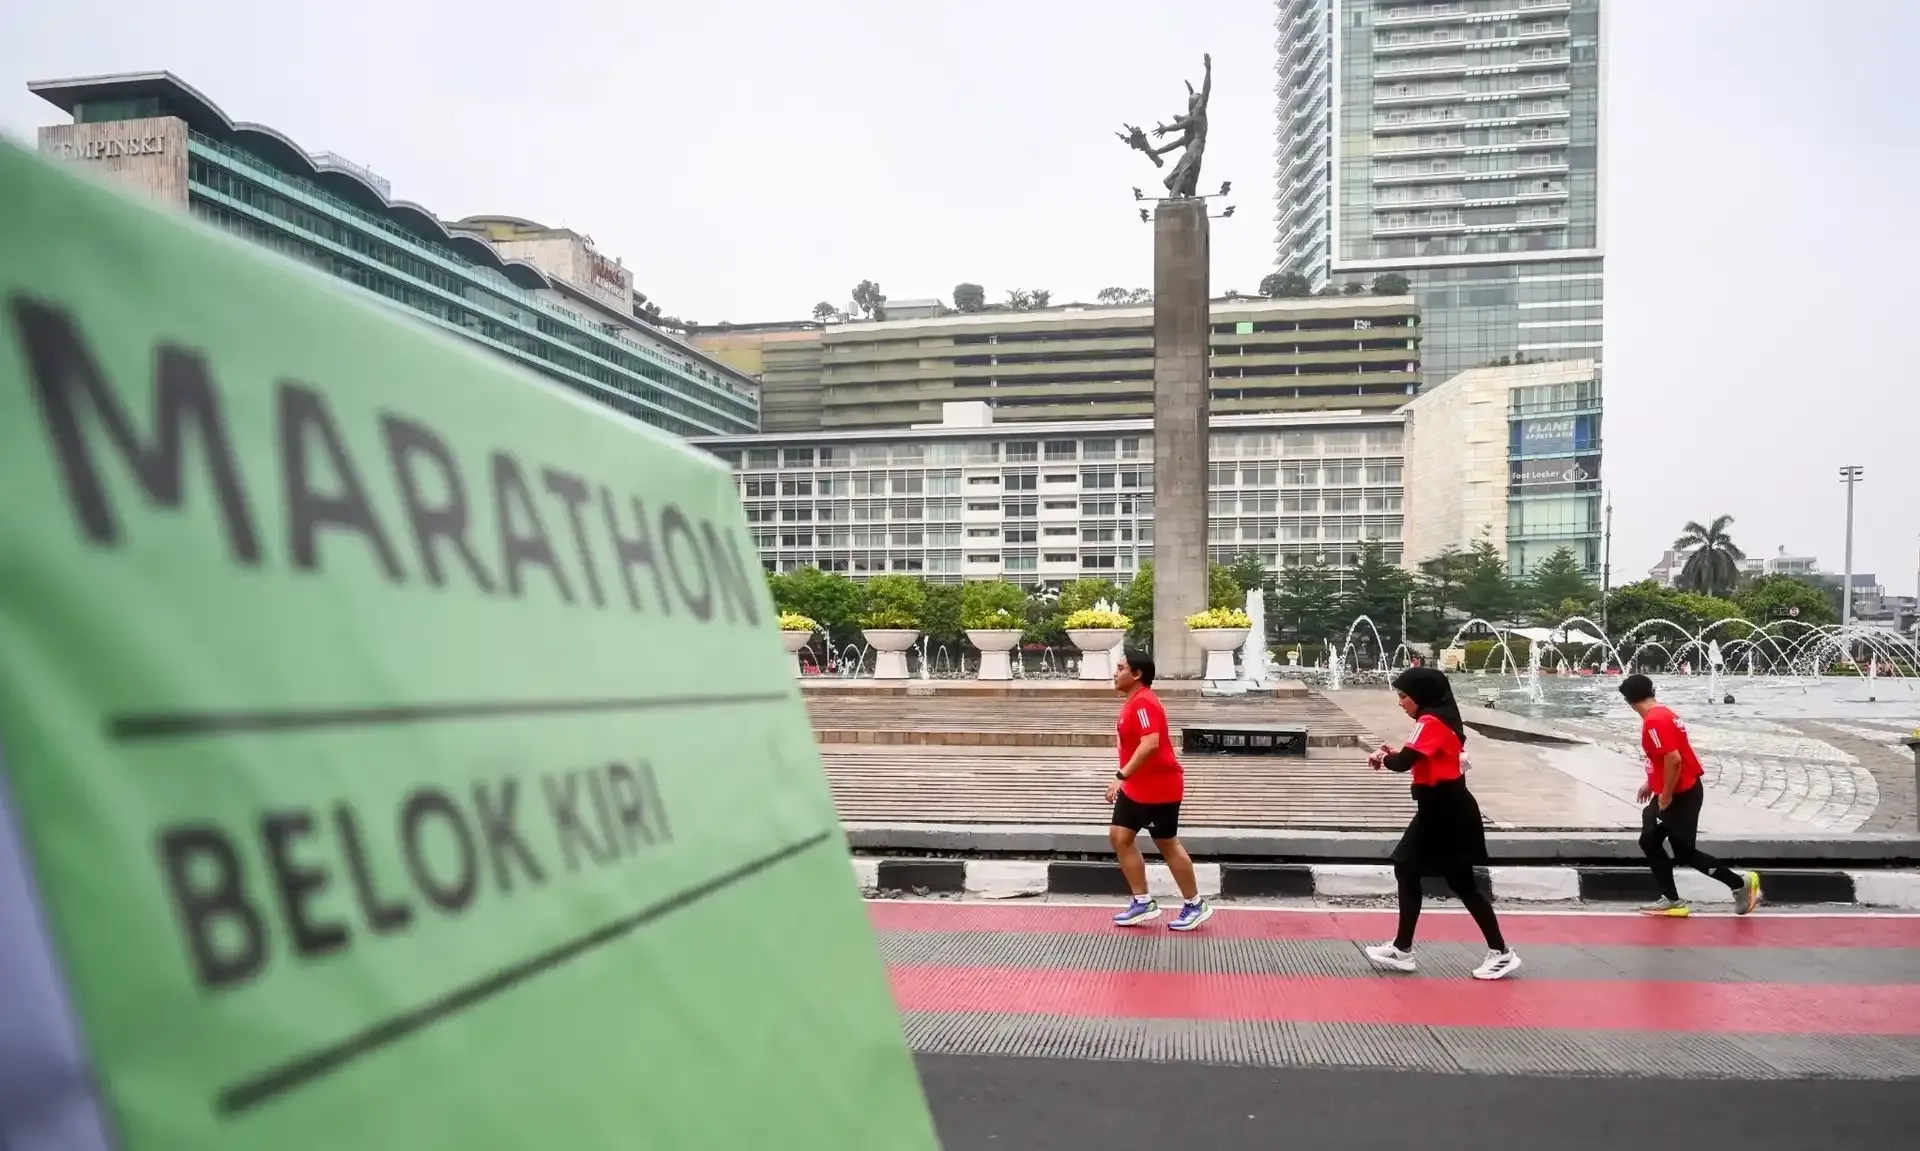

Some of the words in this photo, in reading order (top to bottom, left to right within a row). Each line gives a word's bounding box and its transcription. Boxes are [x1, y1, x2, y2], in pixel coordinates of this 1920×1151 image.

[11, 293, 763, 628] MARATHON
[1512, 471, 1529, 480] Foot
[1532, 470, 1559, 479] Locker
[1528, 420, 1575, 433] PLANET
[155, 775, 546, 990] BELOK
[541, 758, 673, 872] KIRI
